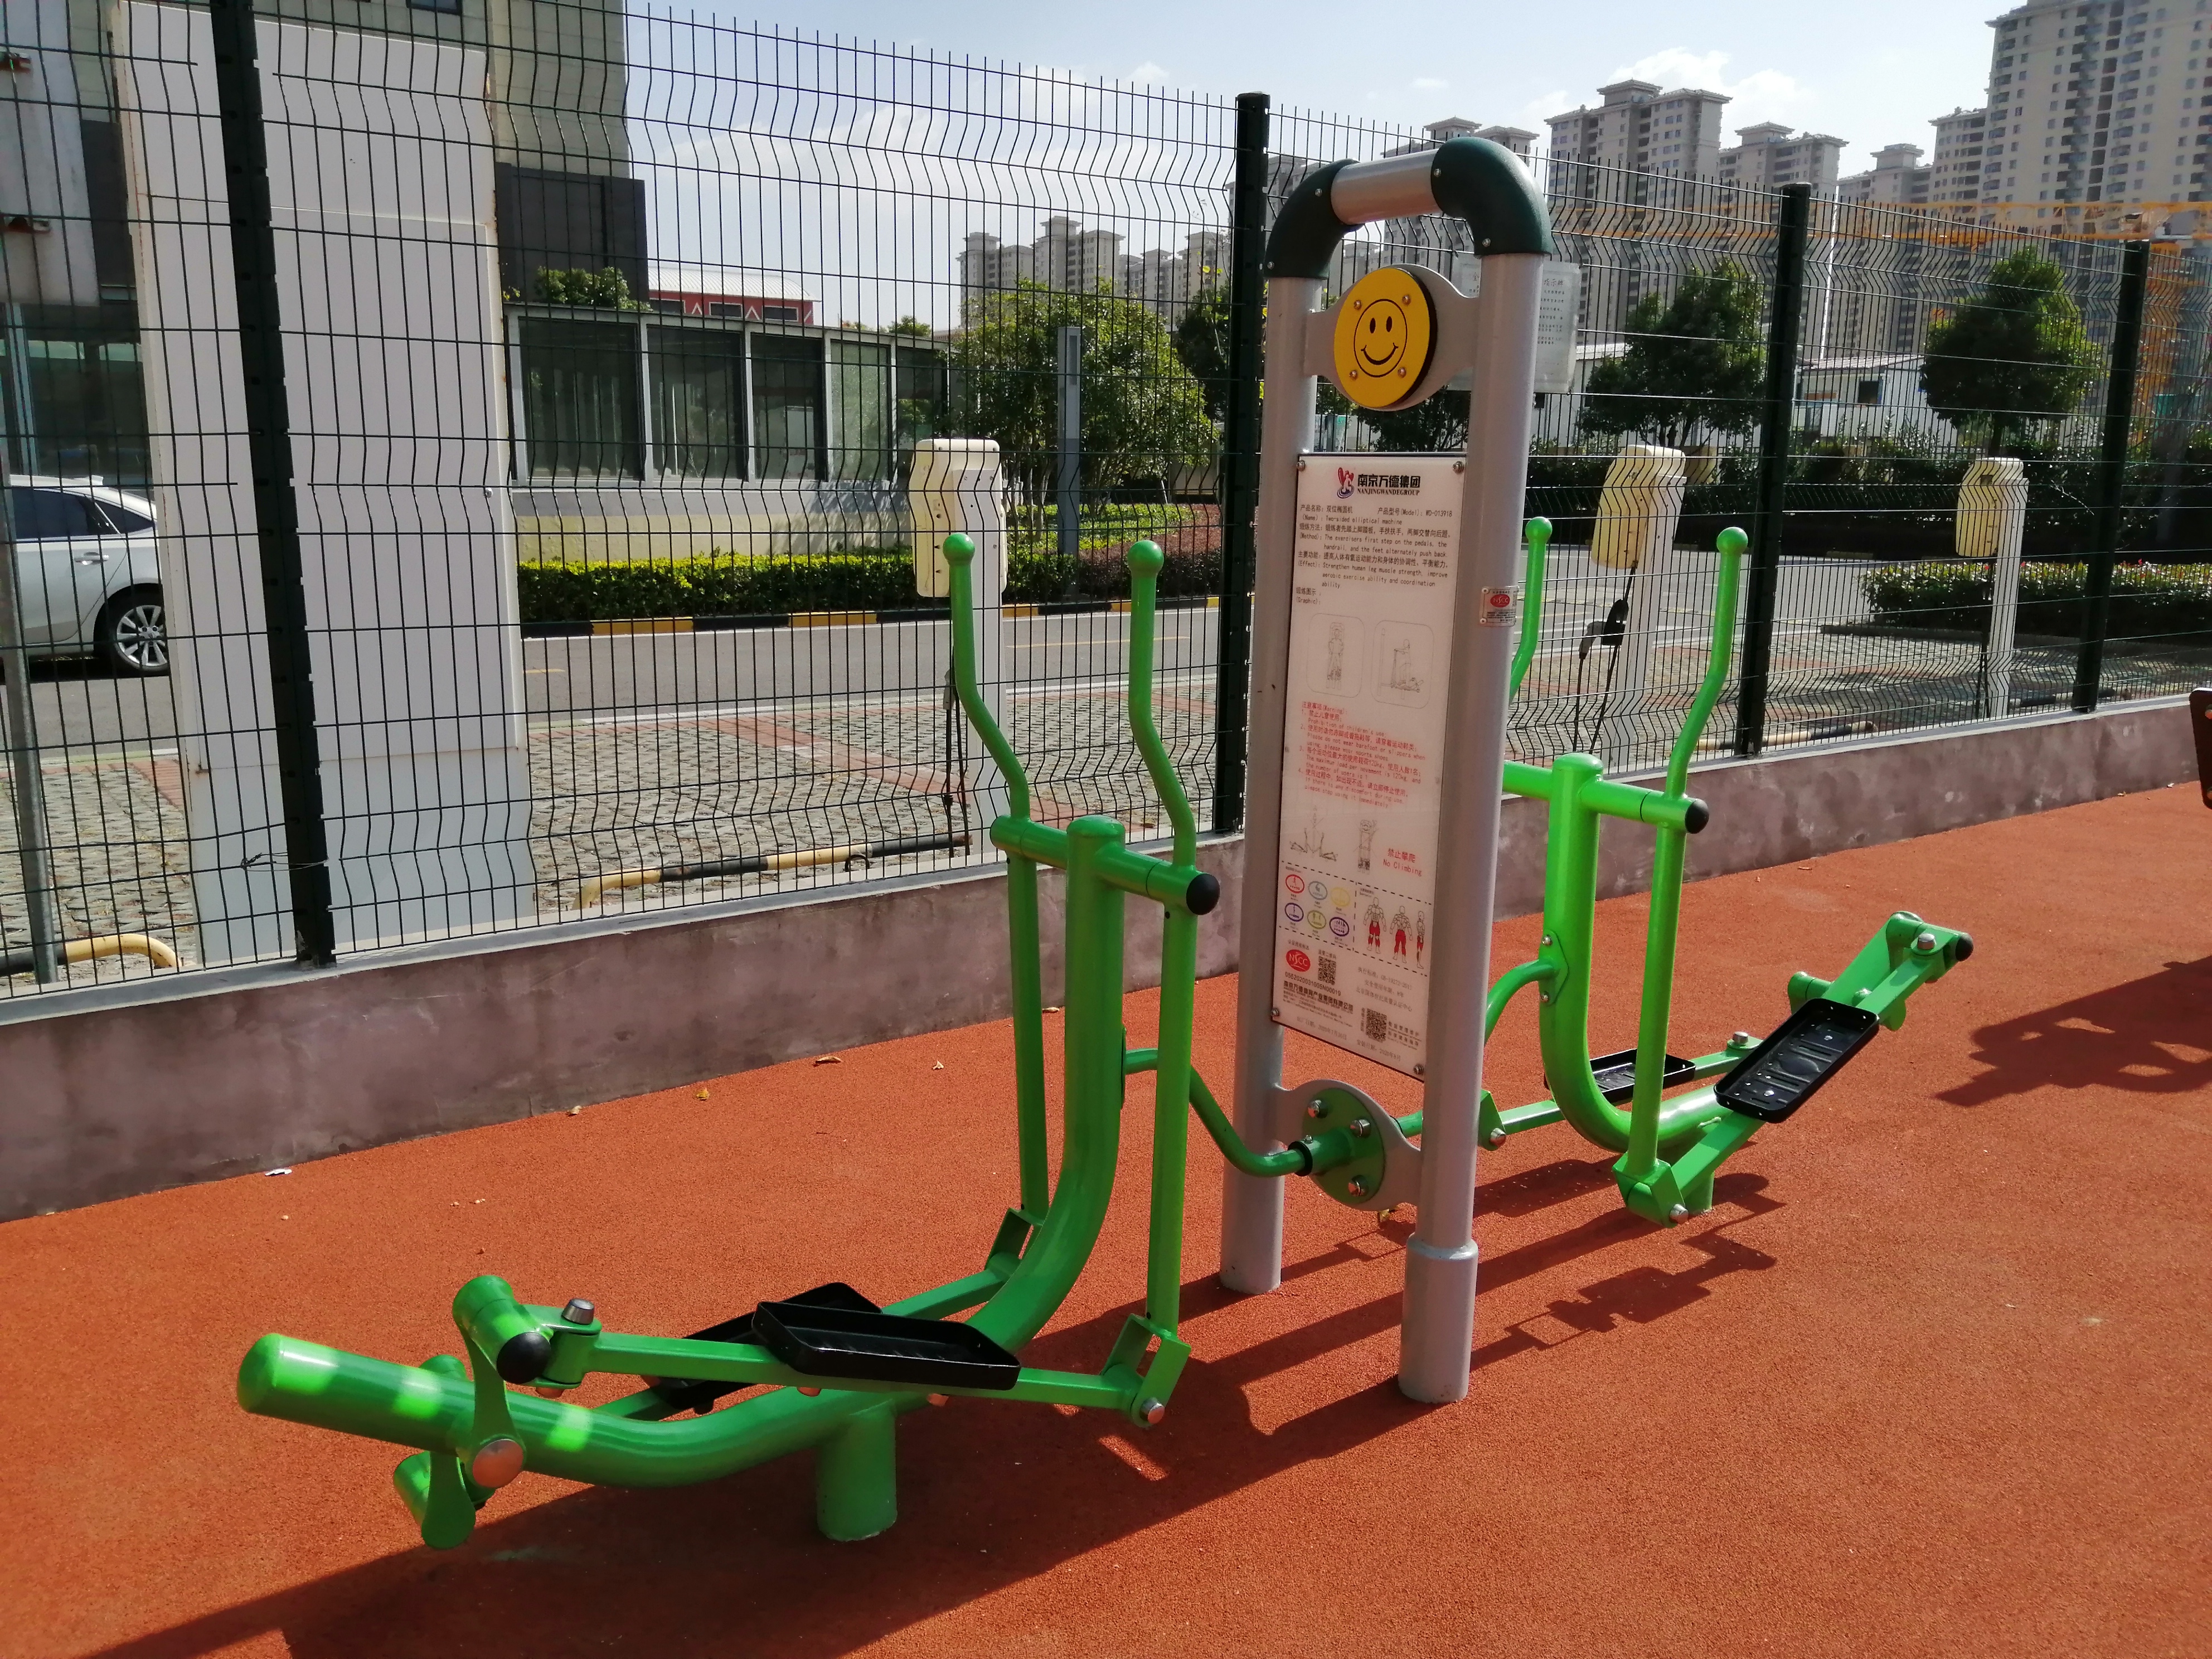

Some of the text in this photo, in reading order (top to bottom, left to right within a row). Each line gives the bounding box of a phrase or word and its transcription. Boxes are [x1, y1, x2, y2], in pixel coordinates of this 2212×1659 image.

[1357, 474, 1421, 488] 南京万德集团
[1367, 575, 1387, 583] ability
[1400, 579, 1435, 587] coordination
[1383, 858, 1422, 877] No Climbing
[1289, 952, 1308, 967] NSCC
